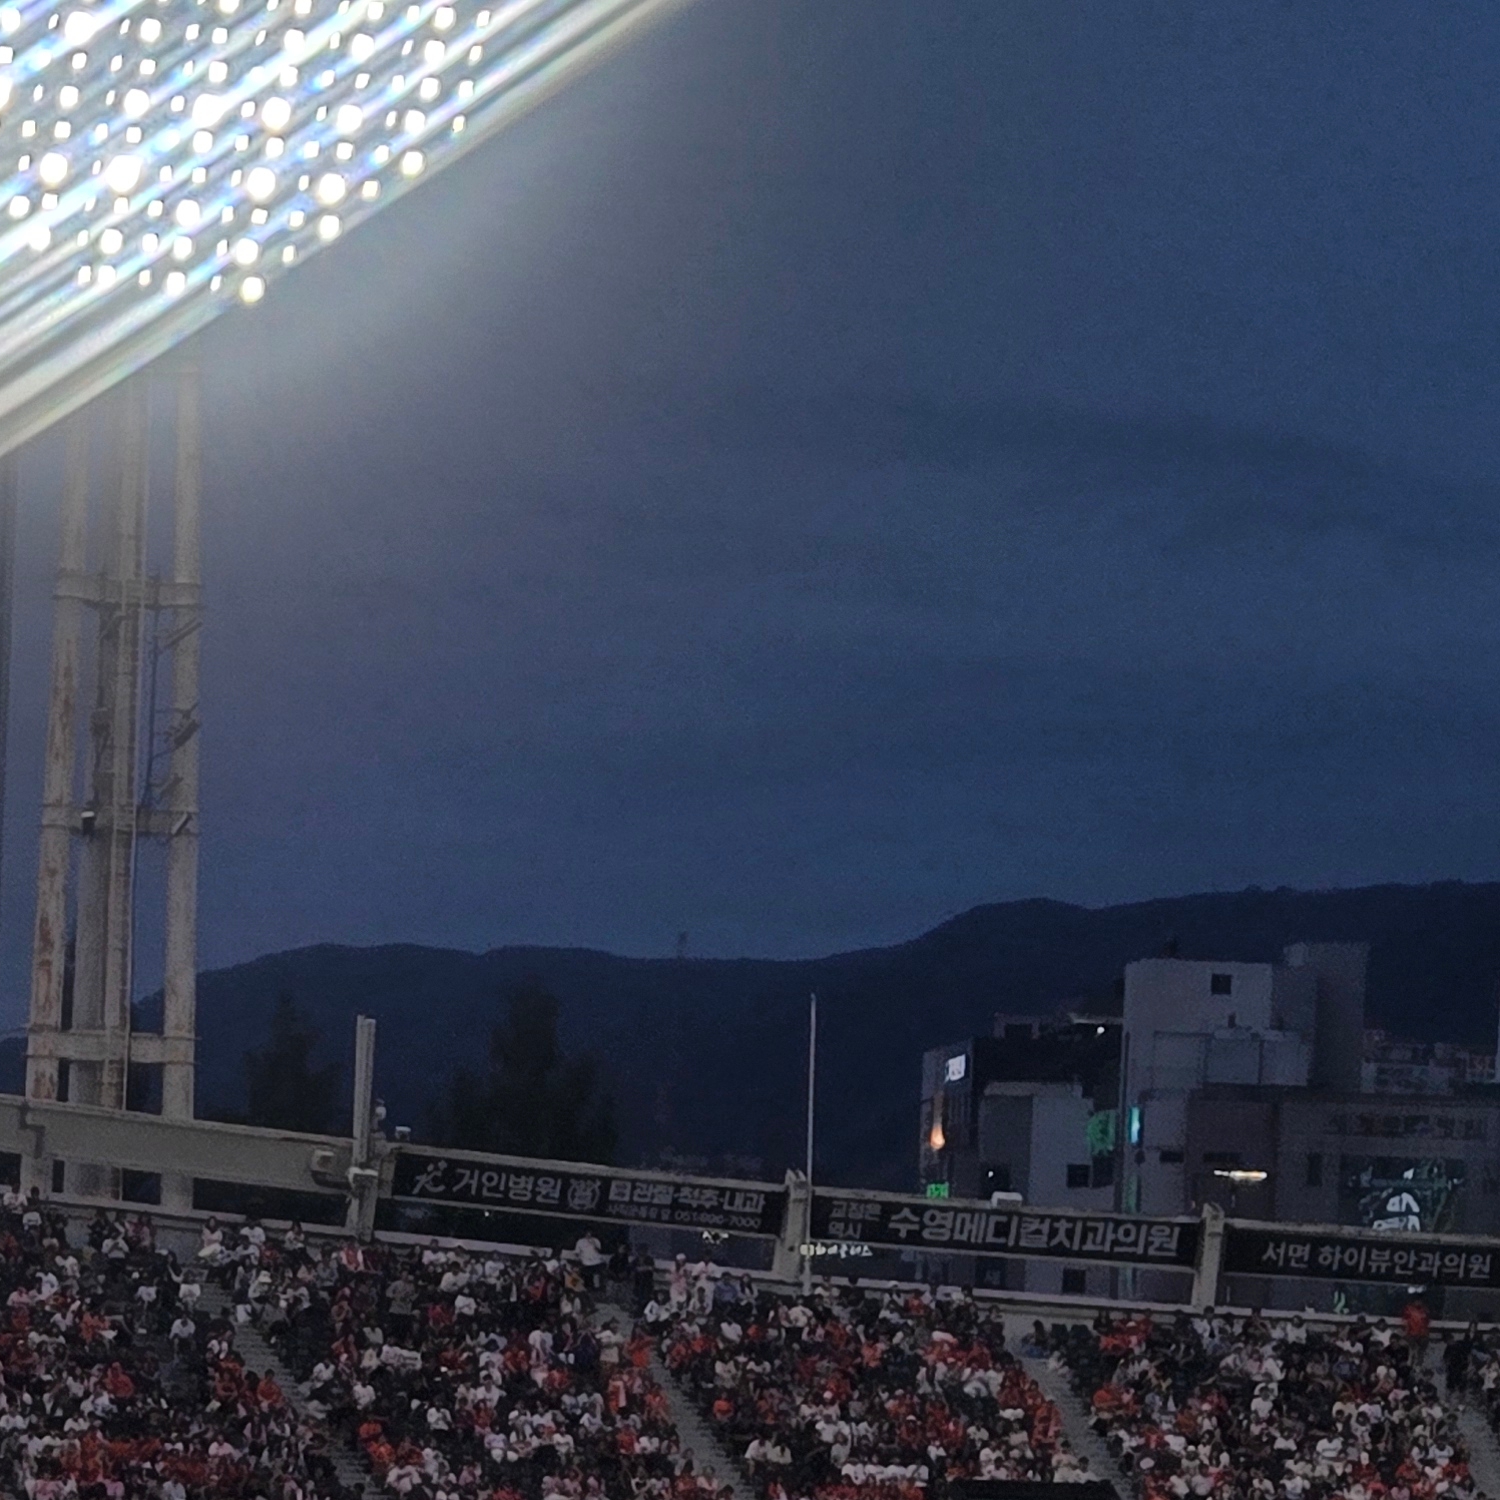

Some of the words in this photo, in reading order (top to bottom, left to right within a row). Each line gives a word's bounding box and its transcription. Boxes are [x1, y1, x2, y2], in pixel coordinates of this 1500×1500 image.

[452, 1168, 562, 1204] 거인병원
[889, 1206, 1181, 1258] 수영메디컬치과의원
[1262, 1242, 1312, 1269] 서면
[1318, 1245, 1492, 1280] 하이뷰안과의원
